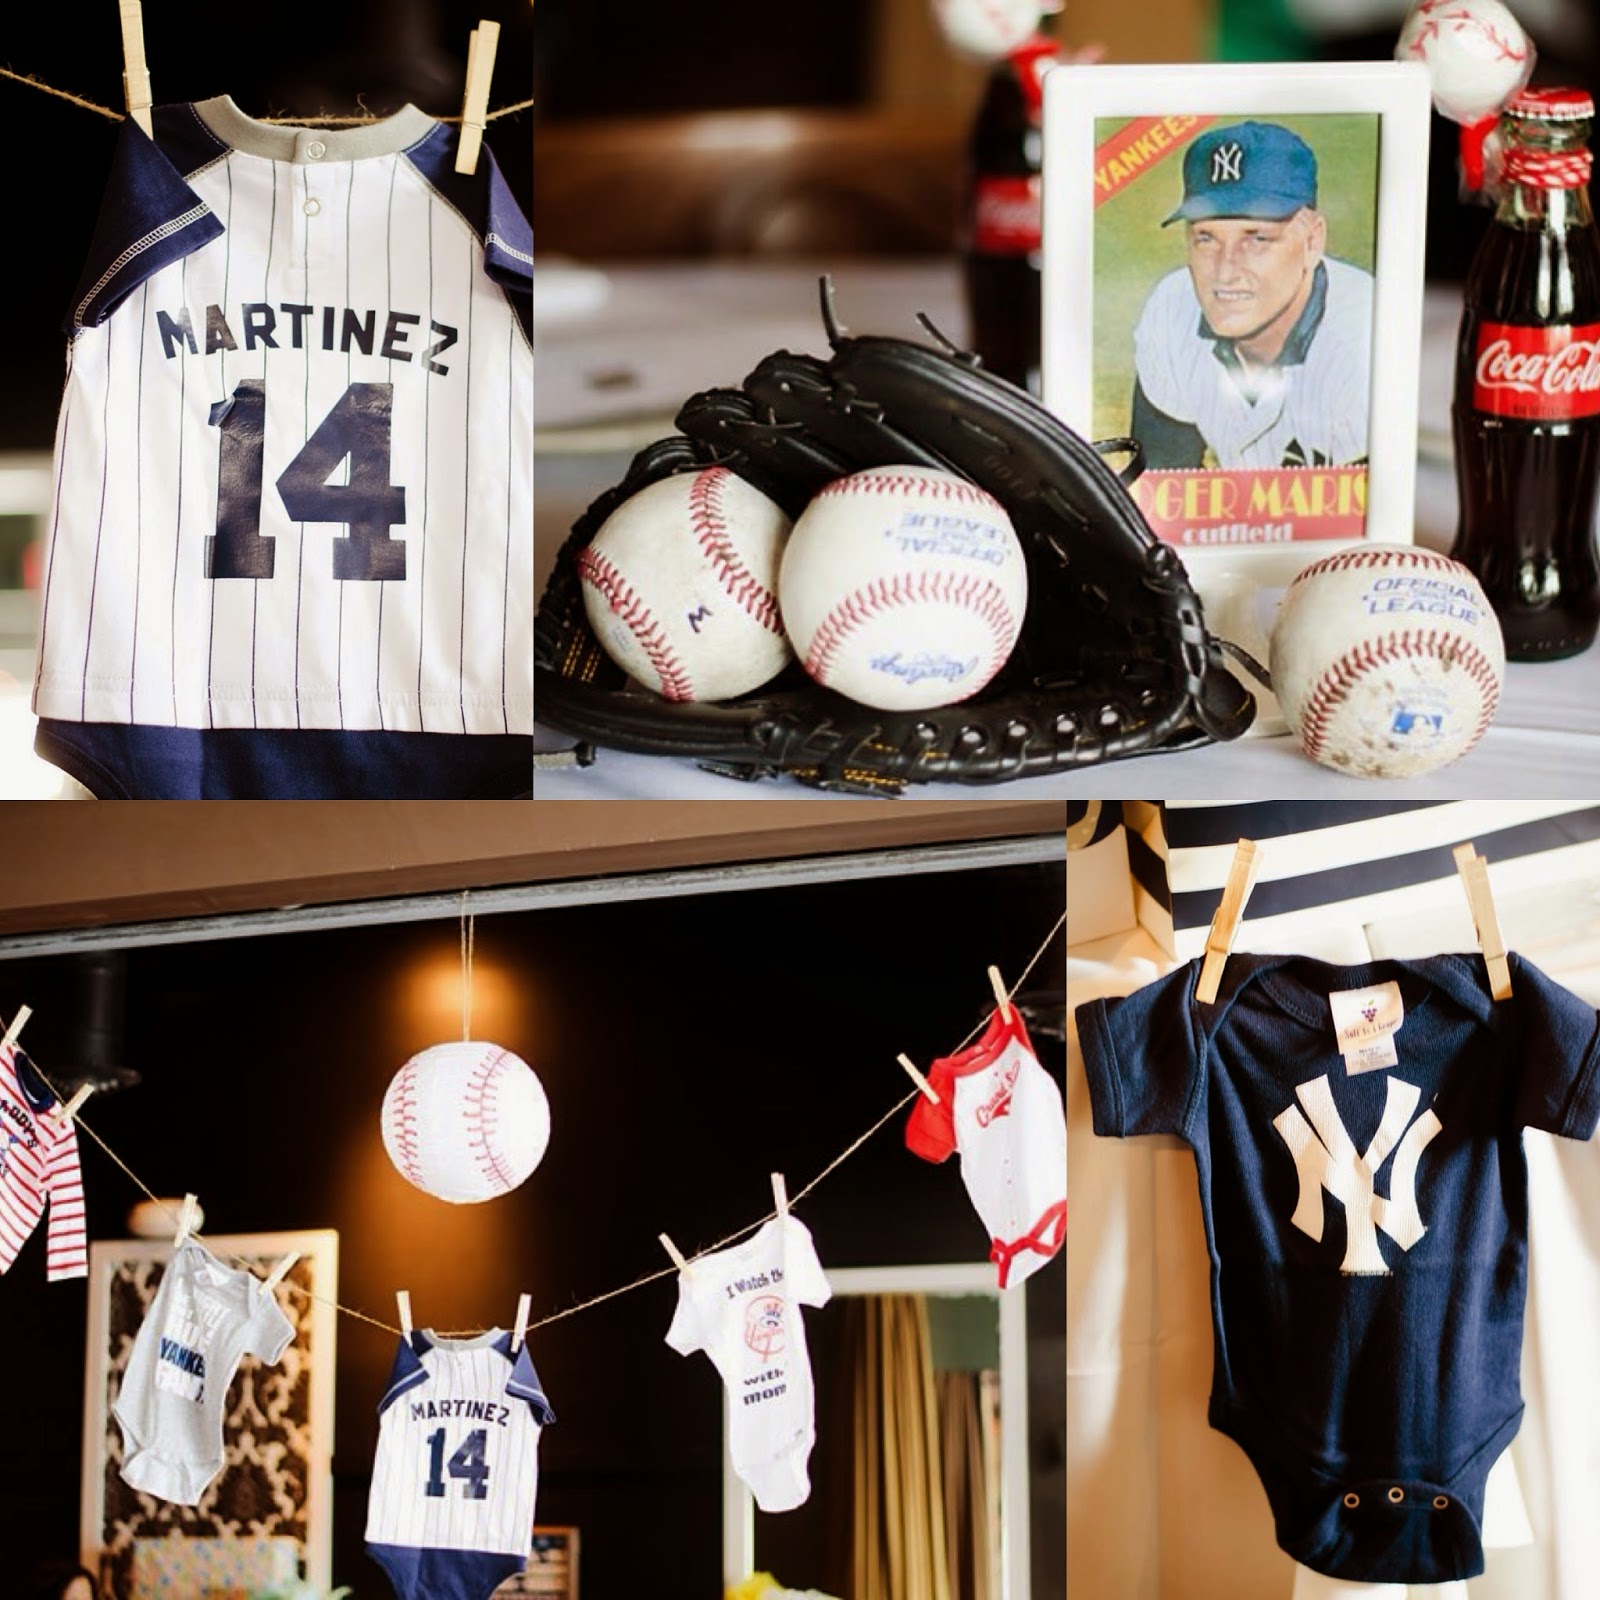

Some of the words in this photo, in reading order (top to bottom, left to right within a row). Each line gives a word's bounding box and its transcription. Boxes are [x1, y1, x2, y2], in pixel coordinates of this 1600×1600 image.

[156, 302, 459, 377] MARTINEZ
[204, 378, 407, 581] 14
[1128, 477, 1239, 521] OGER
[1182, 522, 1293, 545] outfield
[1369, 598, 1478, 625] LEAGUE
[1373, 578, 1479, 606] OFFICIAL
[160, 1337, 206, 1379] YANKE
[411, 1399, 510, 1427] MARTINEZ
[424, 1427, 490, 1500] 14
